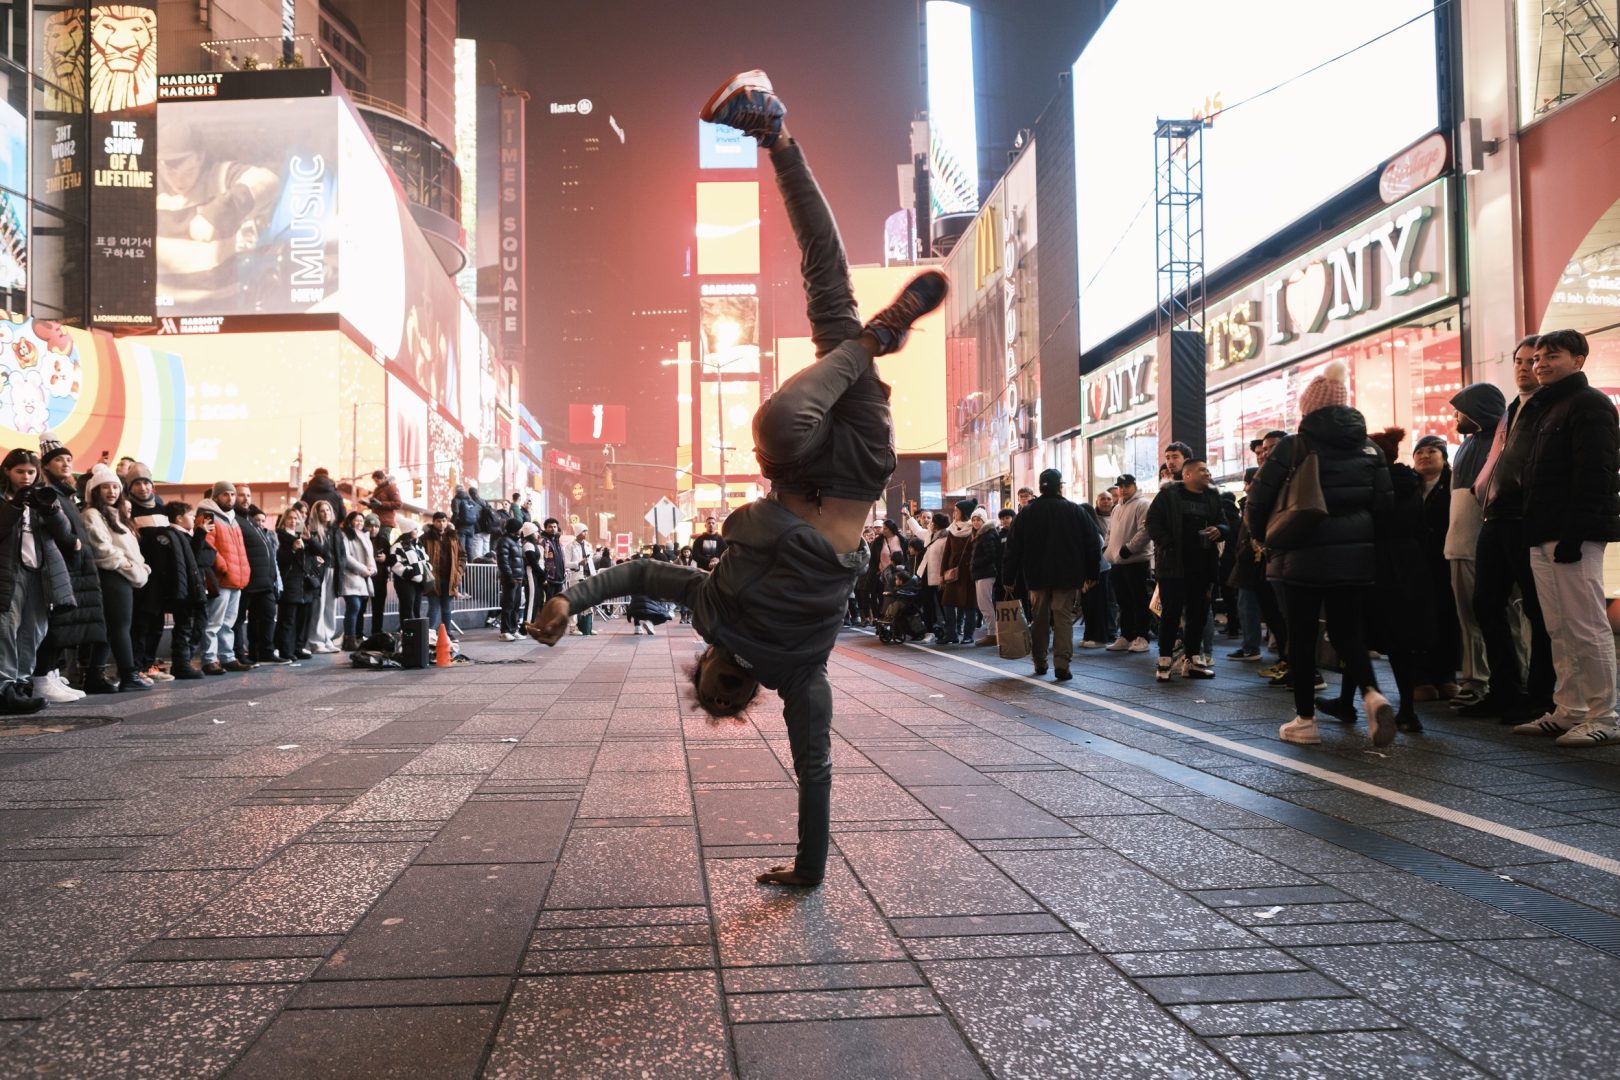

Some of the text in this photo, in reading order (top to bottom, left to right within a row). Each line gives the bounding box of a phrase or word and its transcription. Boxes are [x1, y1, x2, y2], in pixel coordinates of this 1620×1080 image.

[159, 74, 223, 85] MARRIOTT
[159, 85, 216, 96] MARQUIS
[111, 121, 137, 138] THE
[104, 138, 144, 155] SHOW
[110, 155, 138, 171] OF A
[95, 171, 153, 188] LIFETIME
[290, 154, 325, 285] MUSIC
[502, 109, 519, 332] TIMES SQUARE
[119, 236, 152, 248] 여기서
[101, 247, 146, 259] 구하세요
[1266, 279, 1292, 346] I
